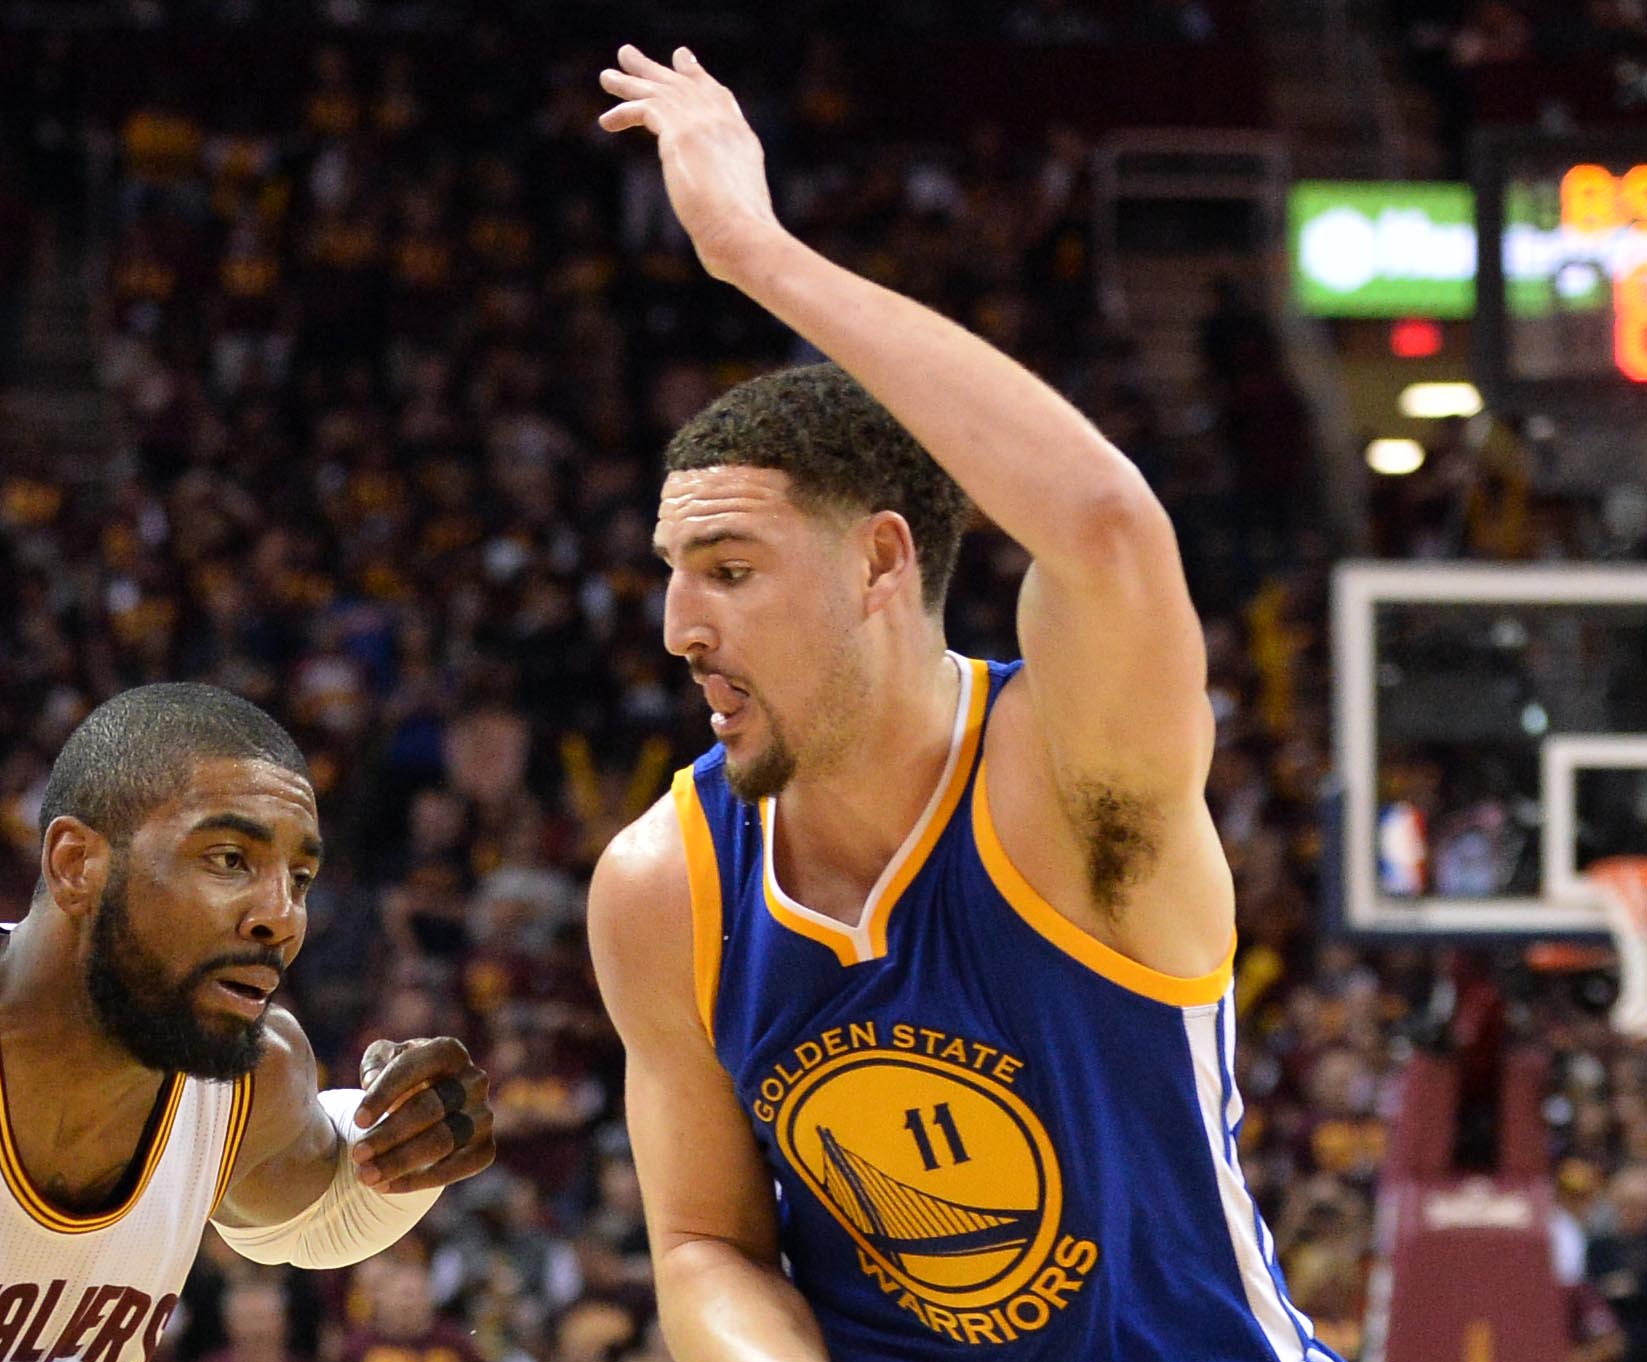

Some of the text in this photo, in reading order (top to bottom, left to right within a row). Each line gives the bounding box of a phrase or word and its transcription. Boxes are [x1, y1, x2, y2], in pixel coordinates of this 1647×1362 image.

[754, 1021, 1024, 1123] GOLDEN STATE
[904, 1102, 971, 1172] 11
[857, 1234, 1098, 1344] WARRIORS
